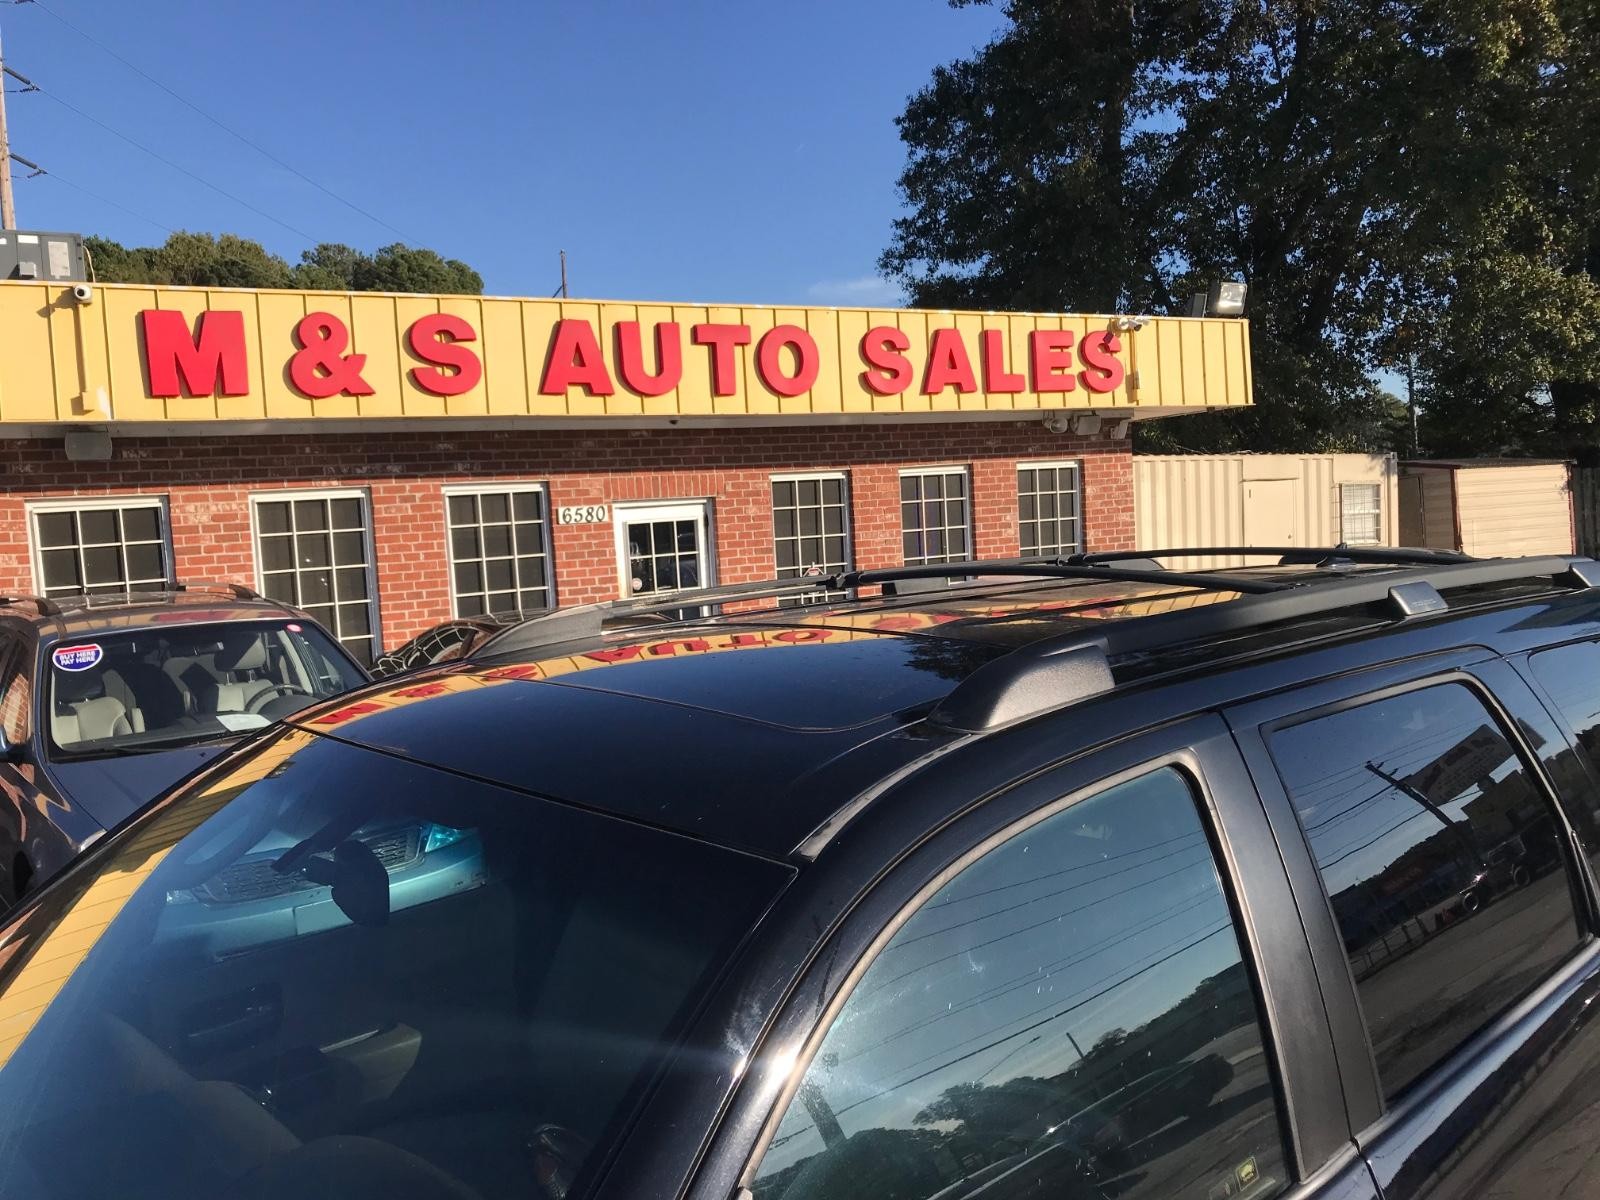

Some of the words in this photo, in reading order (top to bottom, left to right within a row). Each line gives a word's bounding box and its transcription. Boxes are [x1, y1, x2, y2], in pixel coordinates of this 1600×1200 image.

[139, 308, 249, 398] M
[285, 311, 375, 398] &
[408, 313, 482, 396] S
[540, 318, 820, 397] AUTO
[861, 325, 1124, 395] SALES
[562, 505, 606, 524] 6580
[76, 651, 96, 659] HERE
